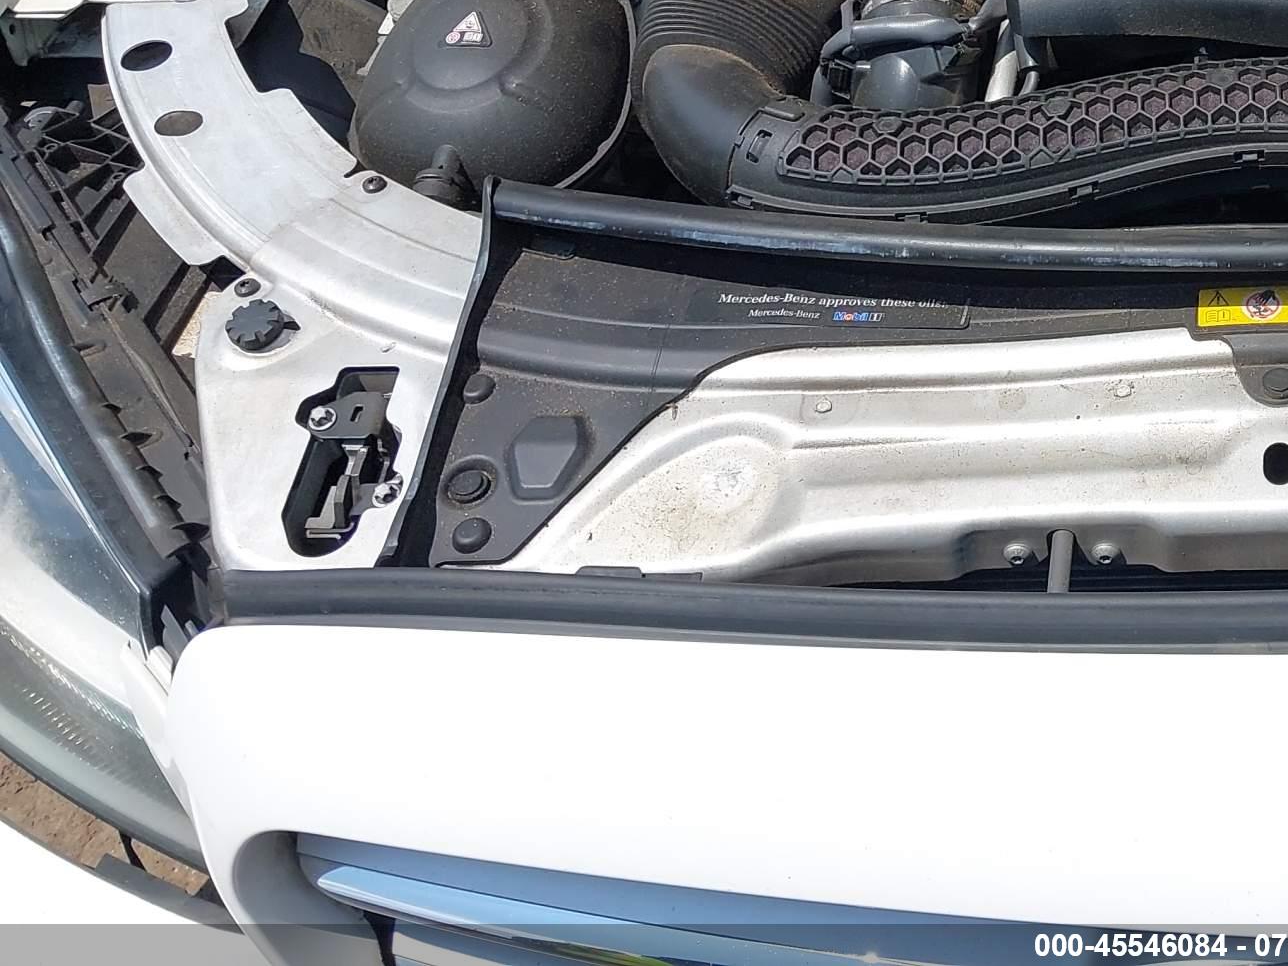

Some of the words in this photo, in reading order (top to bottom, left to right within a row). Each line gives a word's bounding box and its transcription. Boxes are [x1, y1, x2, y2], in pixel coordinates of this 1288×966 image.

[718, 293, 816, 306] Mercedes-Benz
[818, 298, 877, 309] approves
[880, 298, 915, 308] these
[747, 308, 820, 320] Mercedes-Benz
[832, 311, 867, 322] Mobil
